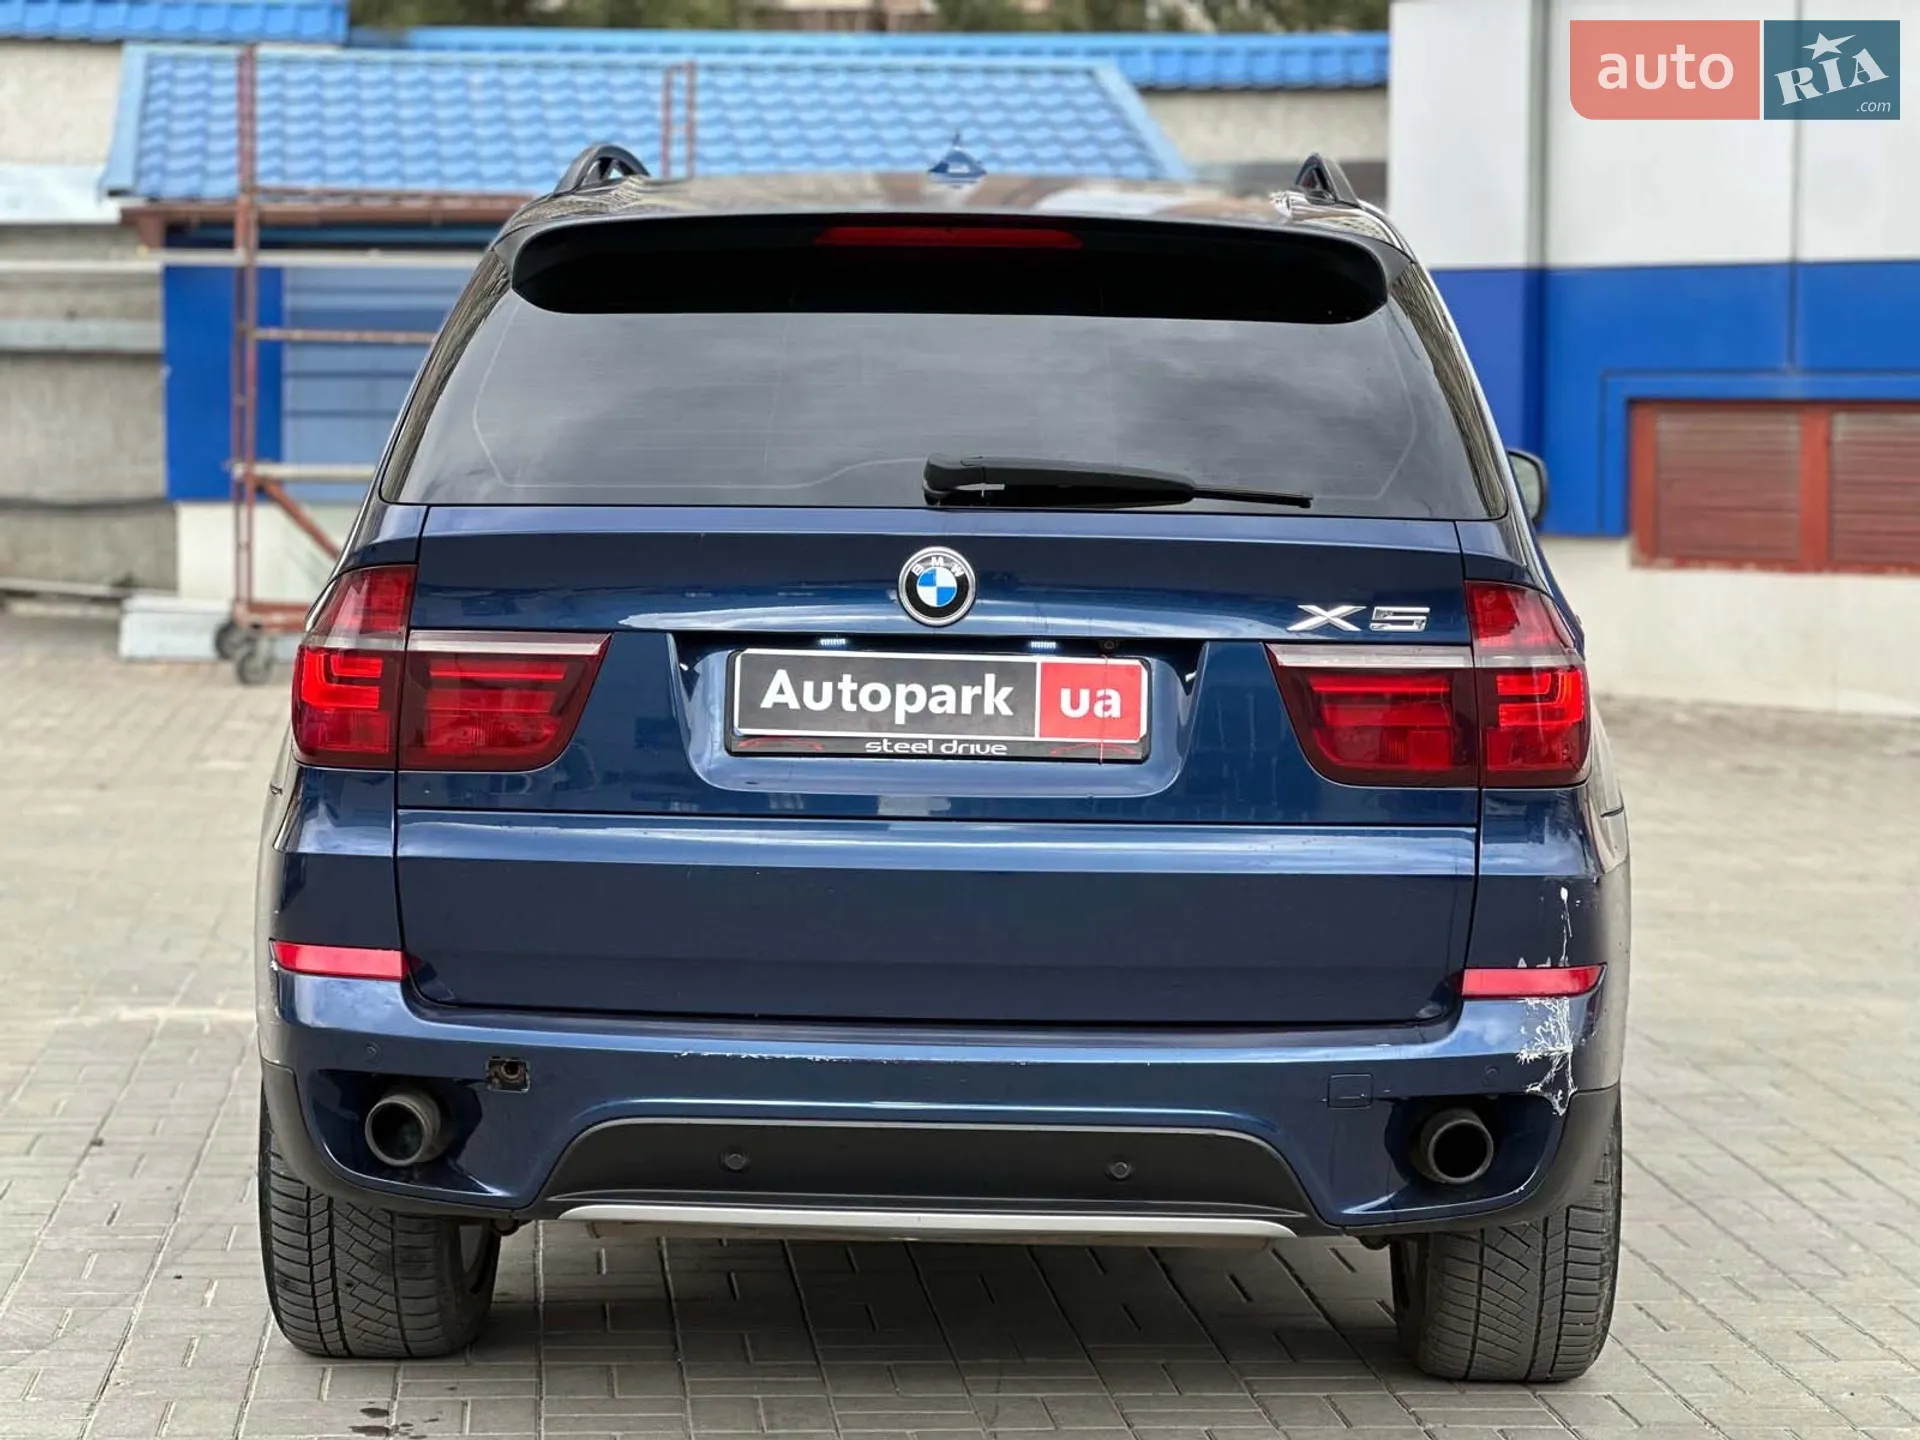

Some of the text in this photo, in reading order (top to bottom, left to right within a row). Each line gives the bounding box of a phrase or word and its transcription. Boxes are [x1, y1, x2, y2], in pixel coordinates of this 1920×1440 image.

[911, 556, 965, 577] BMW
[1286, 604, 1431, 633] X5
[759, 668, 1122, 725] Autopark ua
[864, 738, 1008, 755] steel drive
